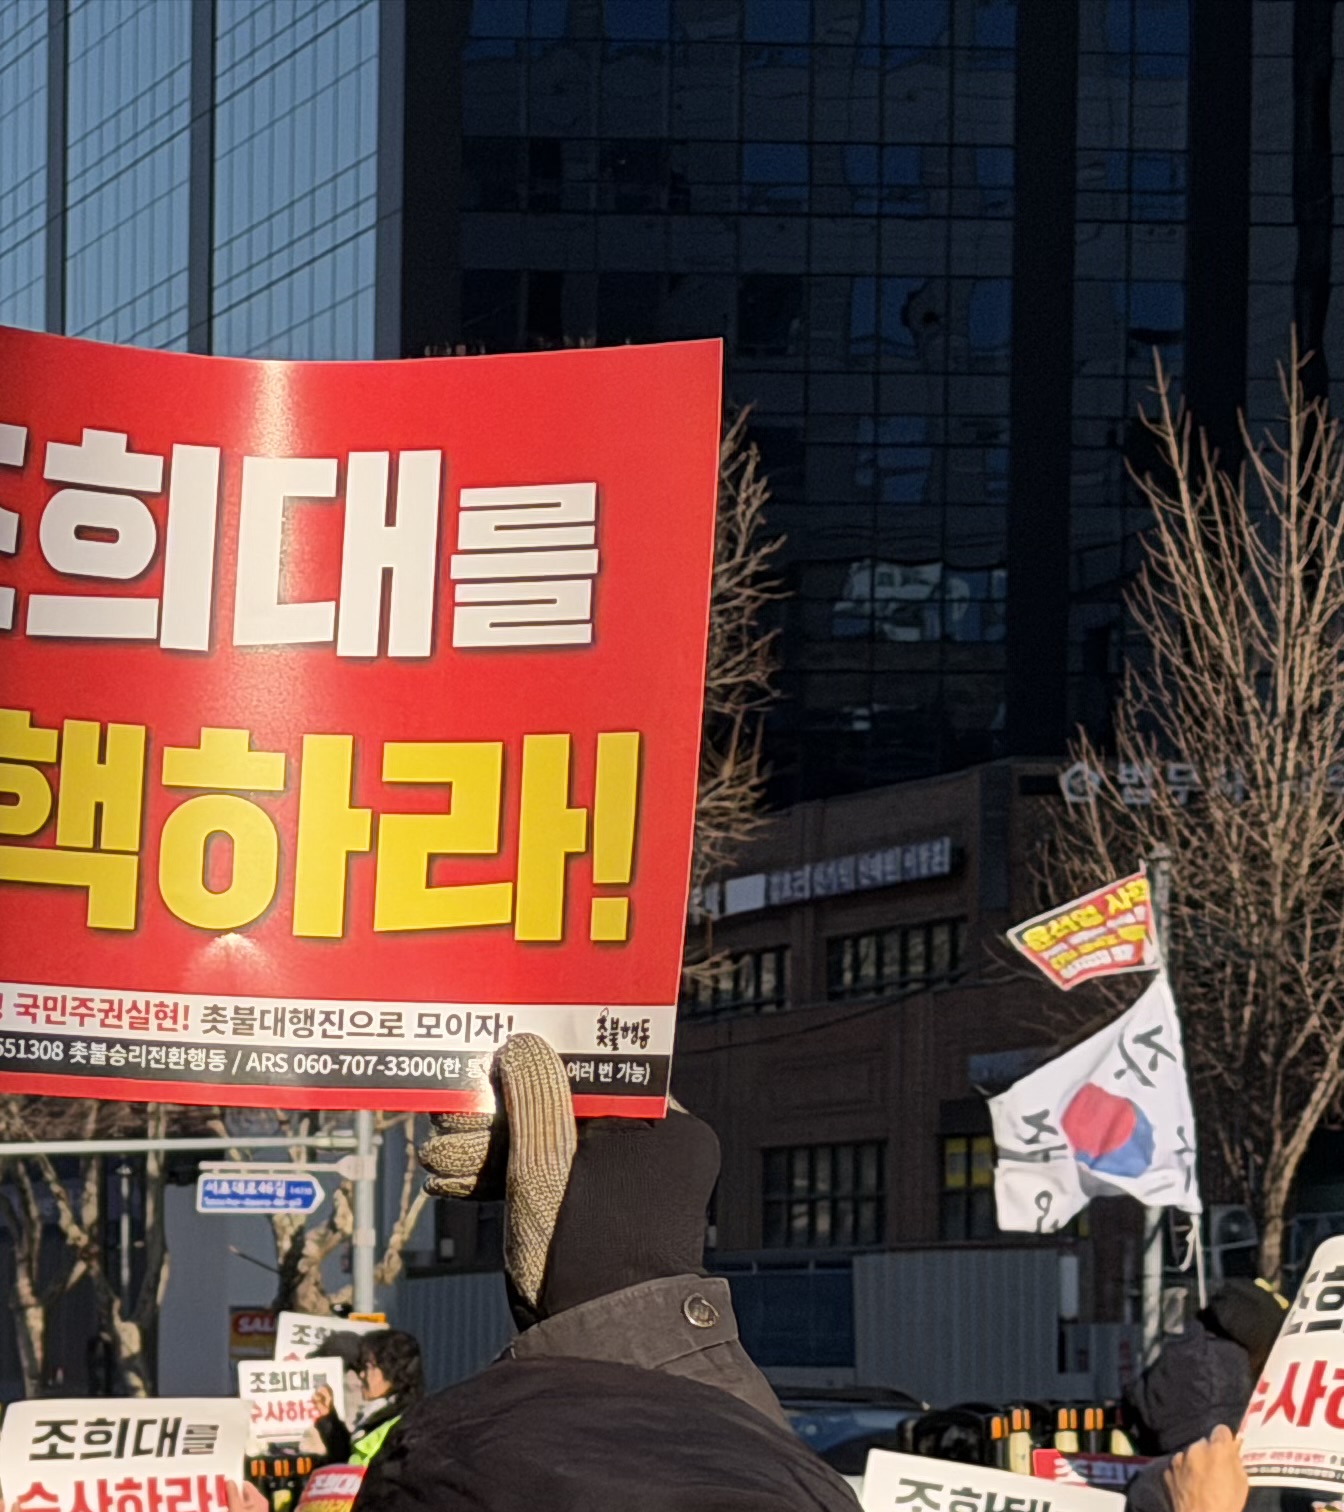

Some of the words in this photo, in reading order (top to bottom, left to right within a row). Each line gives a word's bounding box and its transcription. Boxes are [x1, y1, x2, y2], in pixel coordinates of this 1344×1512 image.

[13, 993, 190, 1032] 국민주권실현!
[200, 1004, 405, 1040] 촛불대행진으로
[417, 1011, 514, 1043] 모이자!
[597, 1008, 651, 1050] 촛불행동
[69, 1043, 228, 1071] 촛불승리전환행동
[246, 1054, 288, 1073] ARS
[293, 1054, 462, 1080] 060-707-3300(한
[567, 1063, 595, 1082] 여러
[598, 1063, 614, 1083] 번
[617, 1063, 651, 1085] 가능)
[237, 1316, 276, 1334] SAL
[28, 1417, 220, 1461] 조희대를
